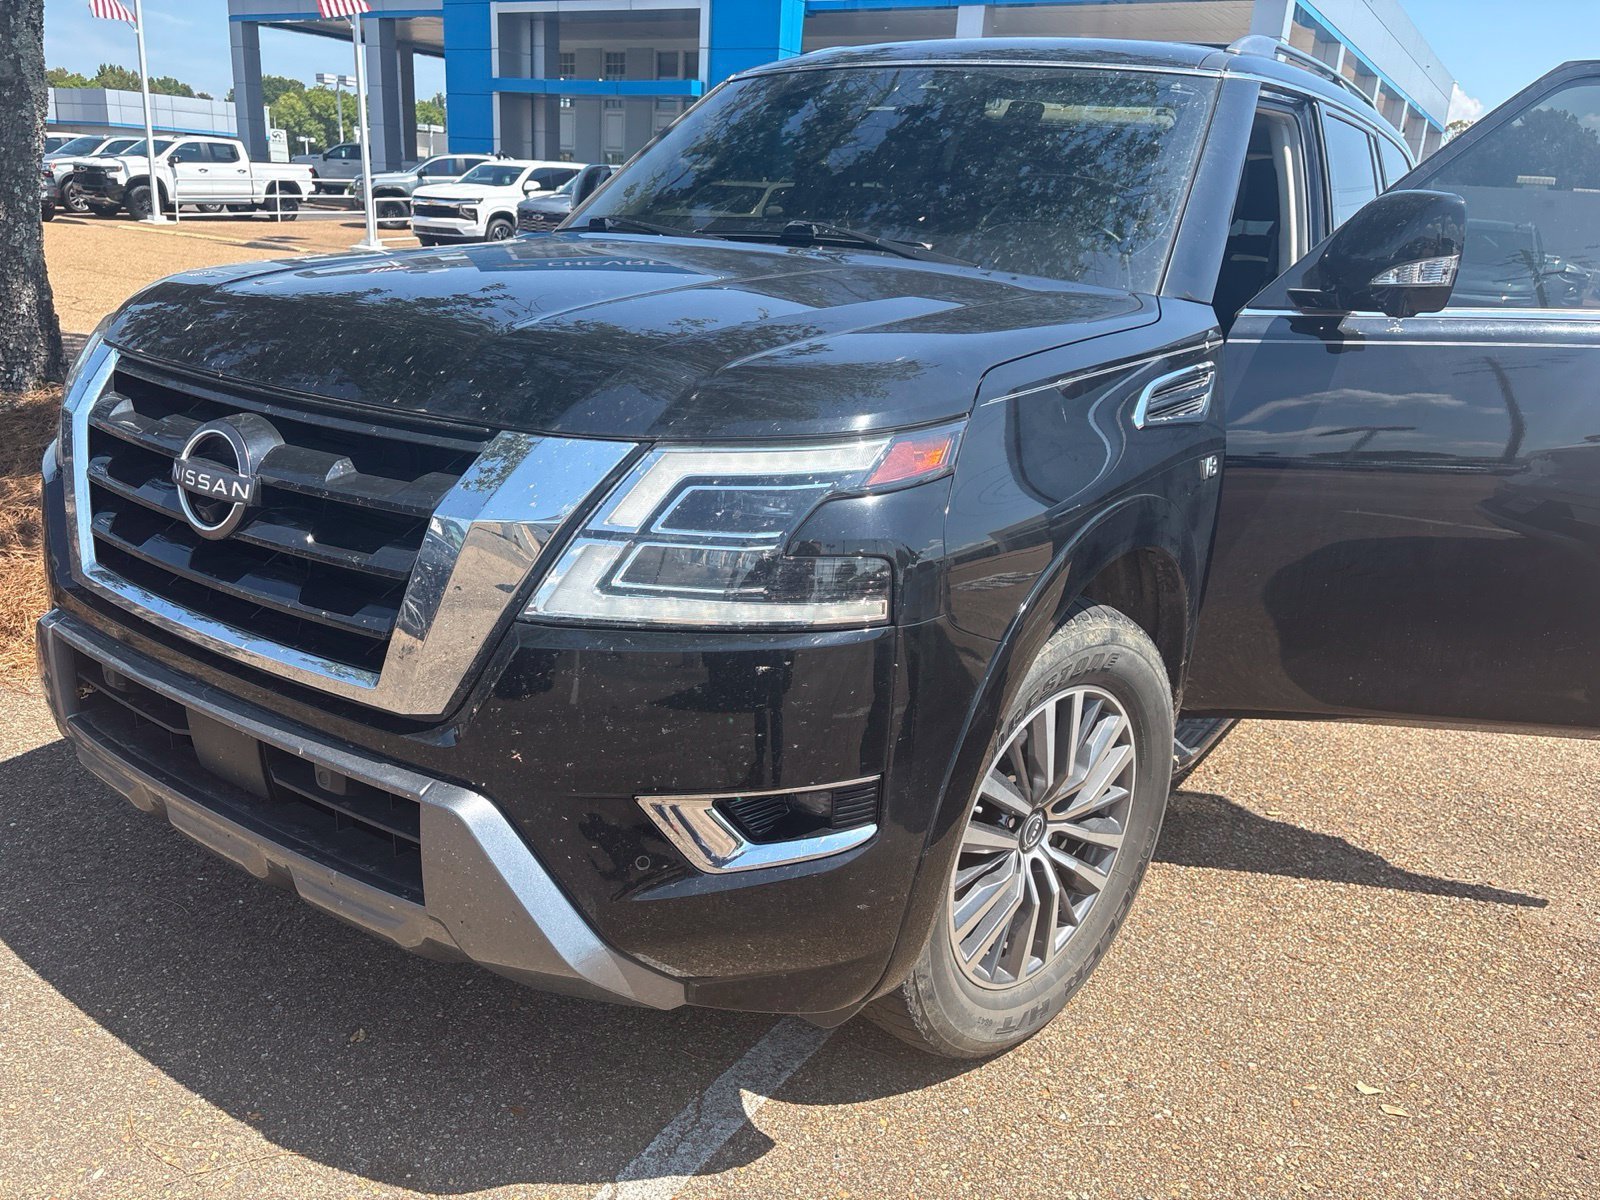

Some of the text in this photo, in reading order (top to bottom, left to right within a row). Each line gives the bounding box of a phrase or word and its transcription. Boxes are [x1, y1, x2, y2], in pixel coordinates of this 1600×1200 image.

[172, 462, 250, 499] NISSAN
[1200, 454, 1218, 480] V8
[994, 998, 1051, 1035] H/T
